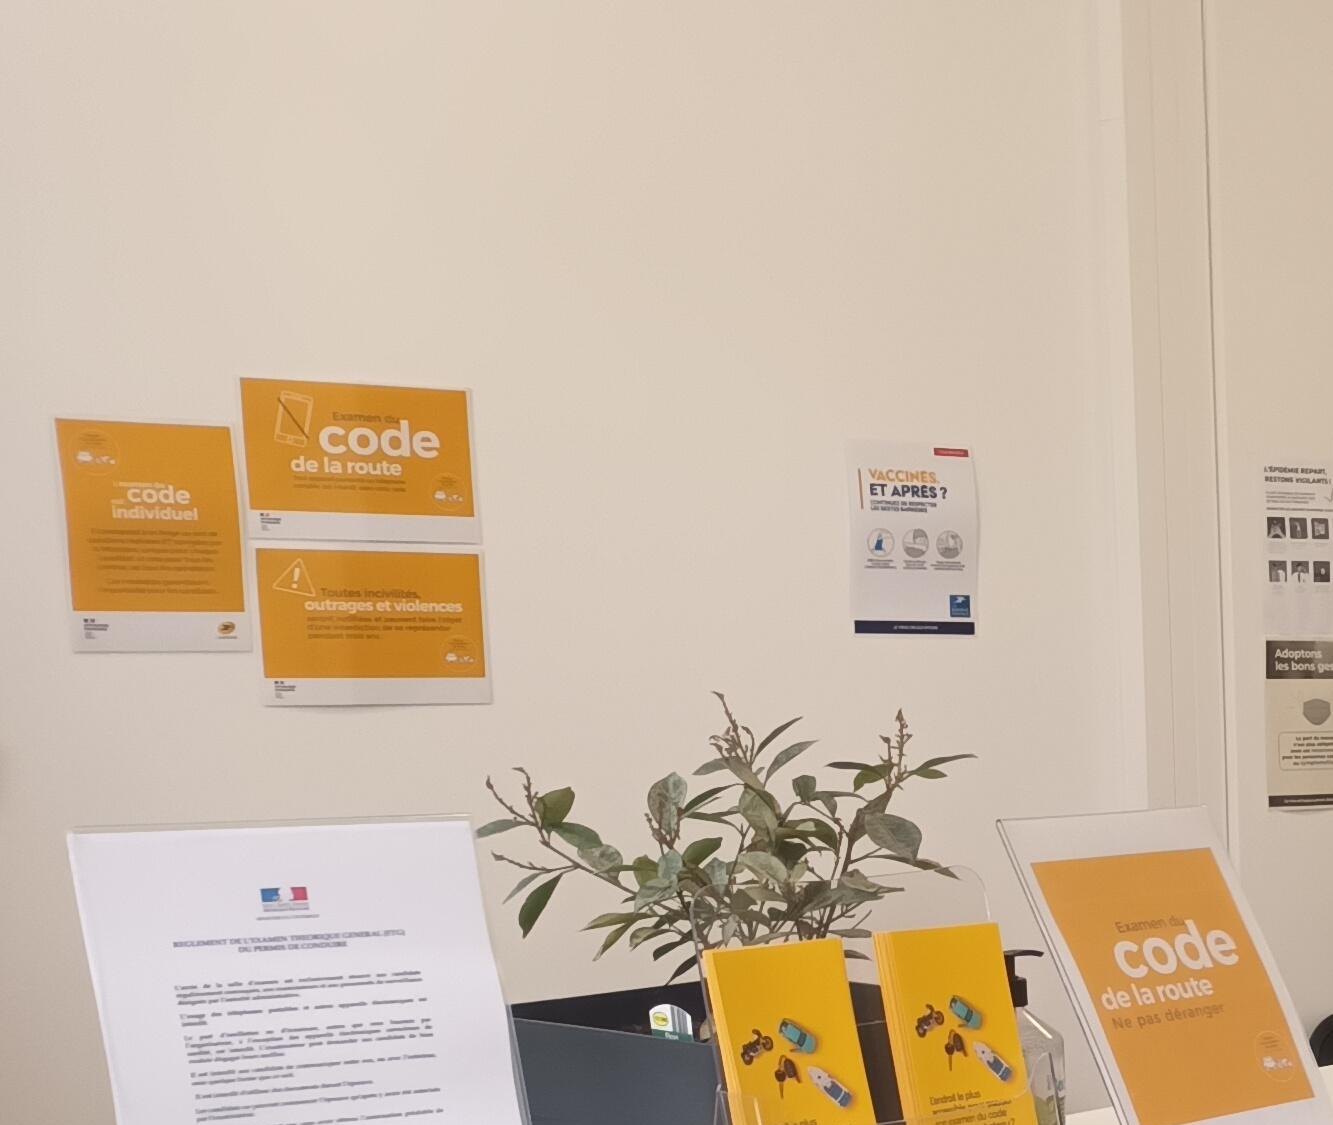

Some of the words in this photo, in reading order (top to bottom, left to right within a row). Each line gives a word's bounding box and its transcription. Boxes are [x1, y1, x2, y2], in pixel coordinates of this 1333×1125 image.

[332, 411, 382, 423] Examen
[319, 419, 440, 459] code
[290, 456, 319, 473] de
[324, 456, 342, 474] la
[347, 460, 402, 476] route
[127, 485, 191, 504] code
[870, 483, 887, 496] ET
[940, 487, 947, 499] ?
[112, 504, 198, 521] individuel
[321, 588, 361, 598] Toutes
[304, 600, 373, 614] outrages
[375, 600, 392, 612] et
[394, 600, 463, 612] violences
[1275, 649, 1322, 659] Adoptons
[1275, 661, 1289, 671] les
[1291, 661, 1316, 671] bons
[1114, 917, 1167, 934] Examen
[1169, 915, 1186, 928] du
[1114, 919, 1240, 978] code
[1101, 988, 1131, 1010] de
[1131, 984, 1155, 1006] la
[1156, 976, 1214, 1003] route
[1112, 1015, 1133, 1030] Ne
[1137, 1014, 1162, 1030] pas
[1166, 1003, 1225, 1022] déranger
